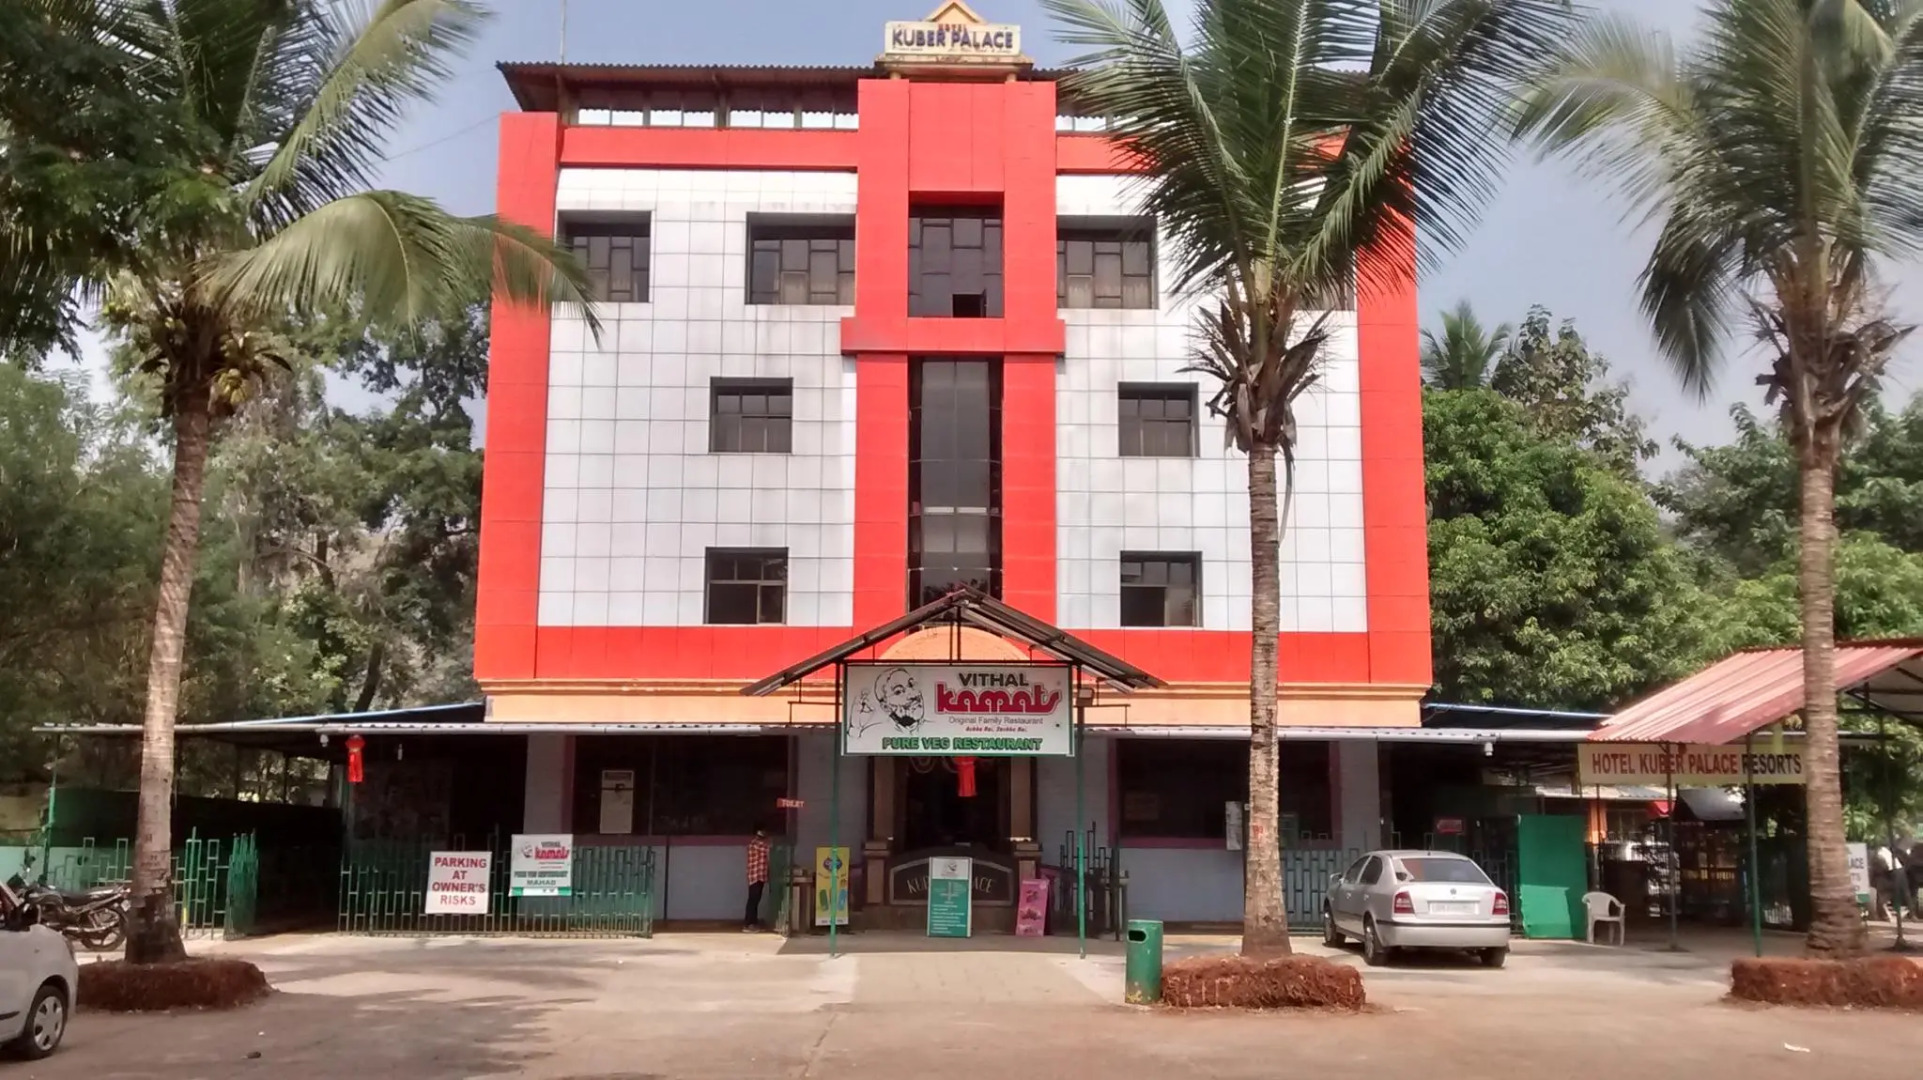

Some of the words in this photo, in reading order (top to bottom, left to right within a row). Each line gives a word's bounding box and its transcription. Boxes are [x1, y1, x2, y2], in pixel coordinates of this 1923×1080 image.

[892, 29, 946, 47] KUBER
[951, 30, 1013, 48] PALACE
[958, 673, 1029, 687] VITHAL
[948, 716, 977, 725] Original
[978, 716, 1003, 725] Family
[1004, 716, 1044, 725] Restaurant
[882, 737, 919, 750] PURE
[921, 737, 950, 750] VEG
[953, 737, 1043, 751] RESTAURANT
[1592, 752, 1636, 775] HOTEL
[1639, 752, 1684, 775] KUBER
[1688, 752, 1738, 775] PALACE
[1741, 753, 1802, 775] RESORTS
[434, 856, 487, 868] PARKING
[452, 870, 468, 880] AT
[432, 881, 486, 893] OWNER'S
[440, 895, 476, 906] RISKS
